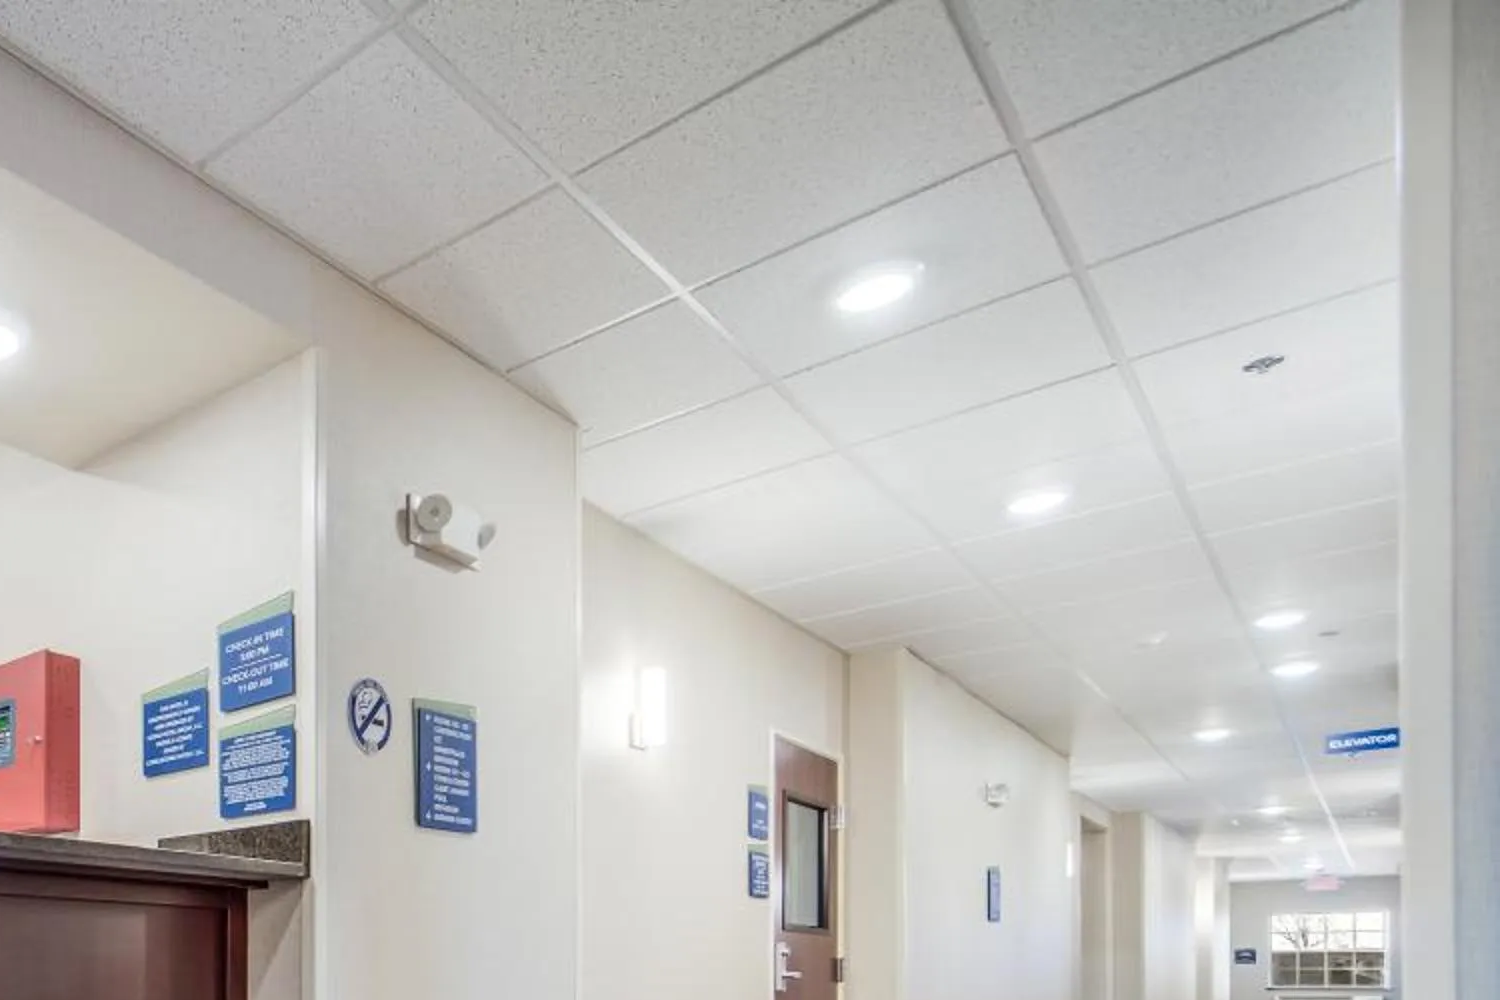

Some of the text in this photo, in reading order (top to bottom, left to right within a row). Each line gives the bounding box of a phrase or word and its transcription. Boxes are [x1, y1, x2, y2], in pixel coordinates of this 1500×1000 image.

[264, 627, 284, 641] TIME
[222, 657, 289, 685] CHECK-OUT TIME
[1329, 733, 1397, 749] ELEVATOR
